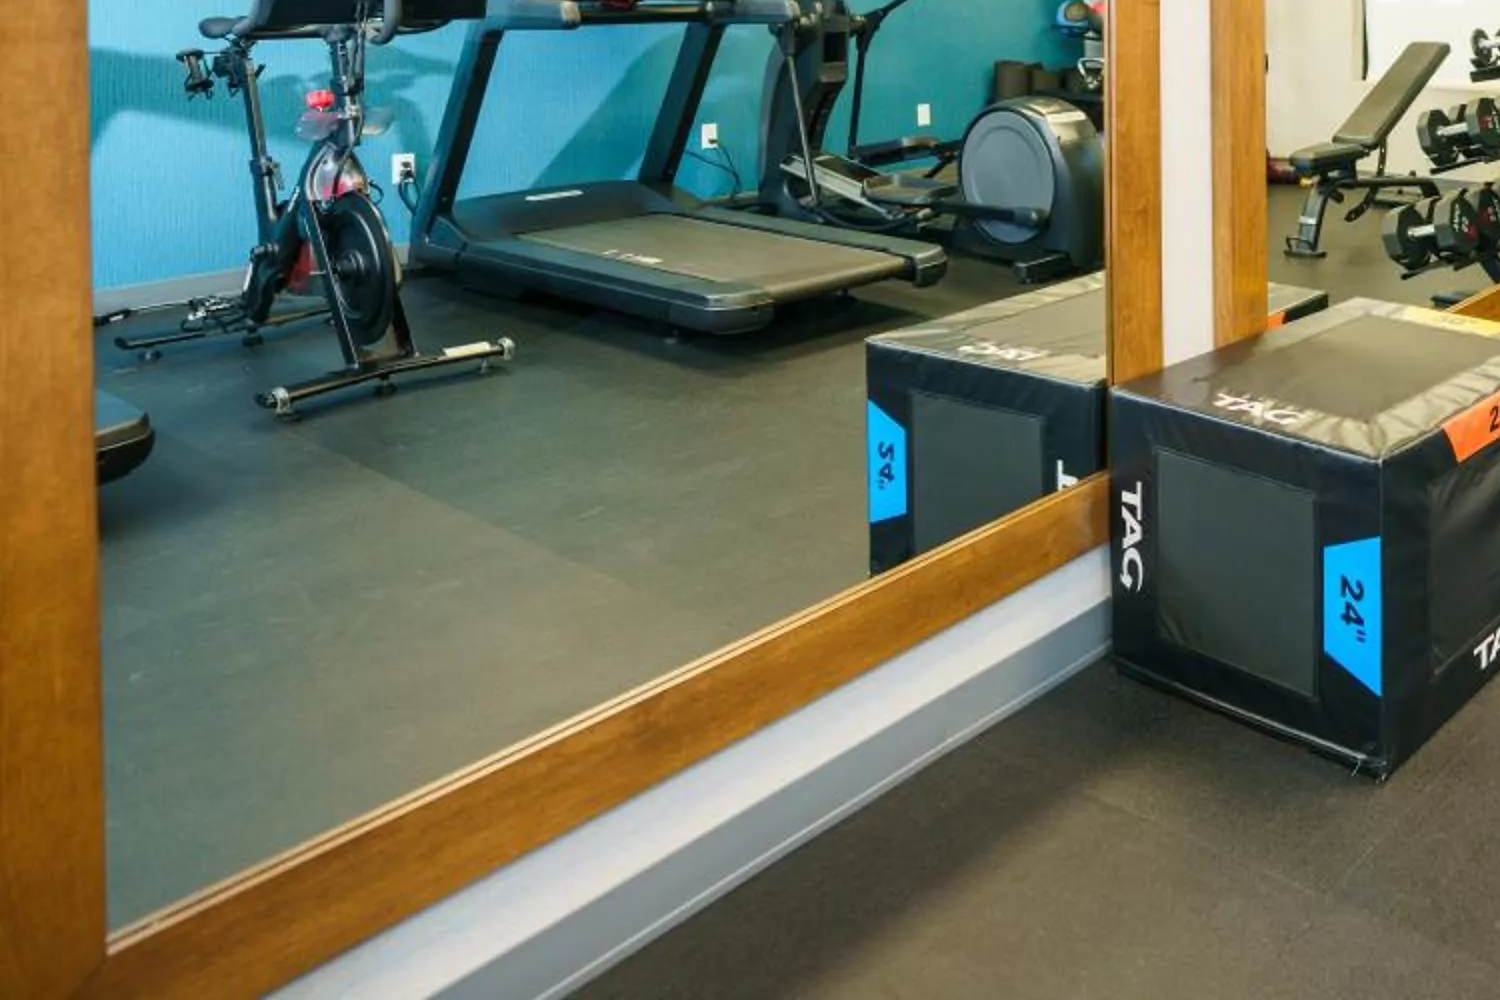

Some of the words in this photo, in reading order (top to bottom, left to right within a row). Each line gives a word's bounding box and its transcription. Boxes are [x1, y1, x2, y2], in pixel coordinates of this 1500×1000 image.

[1212, 393, 1307, 425] TAG
[1120, 481, 1143, 593] TAG
[1340, 574, 1365, 645] 24"
